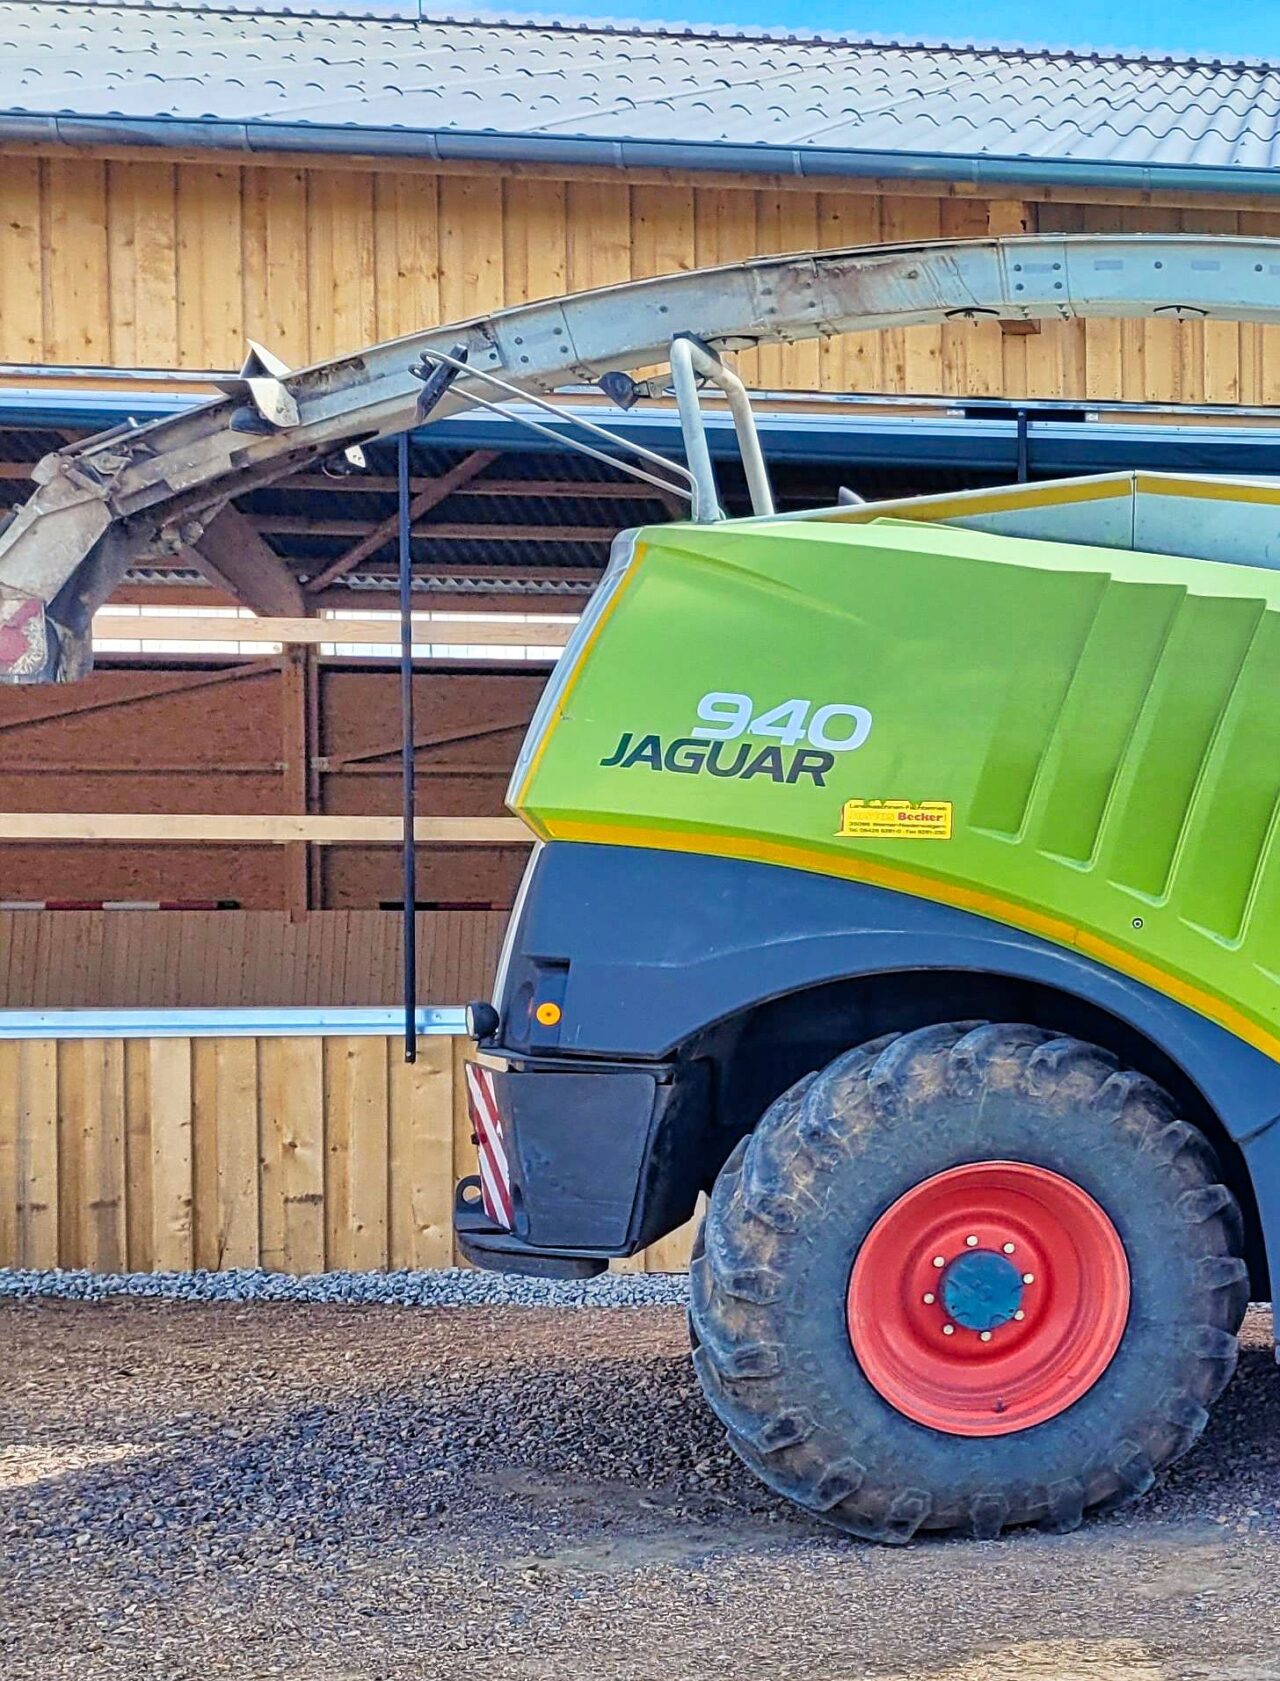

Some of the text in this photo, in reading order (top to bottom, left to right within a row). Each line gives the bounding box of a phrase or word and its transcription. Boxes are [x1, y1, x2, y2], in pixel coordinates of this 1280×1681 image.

[691, 691, 873, 752] 940
[600, 732, 835, 787] JAGUAR
[897, 812, 944, 822] Becker
